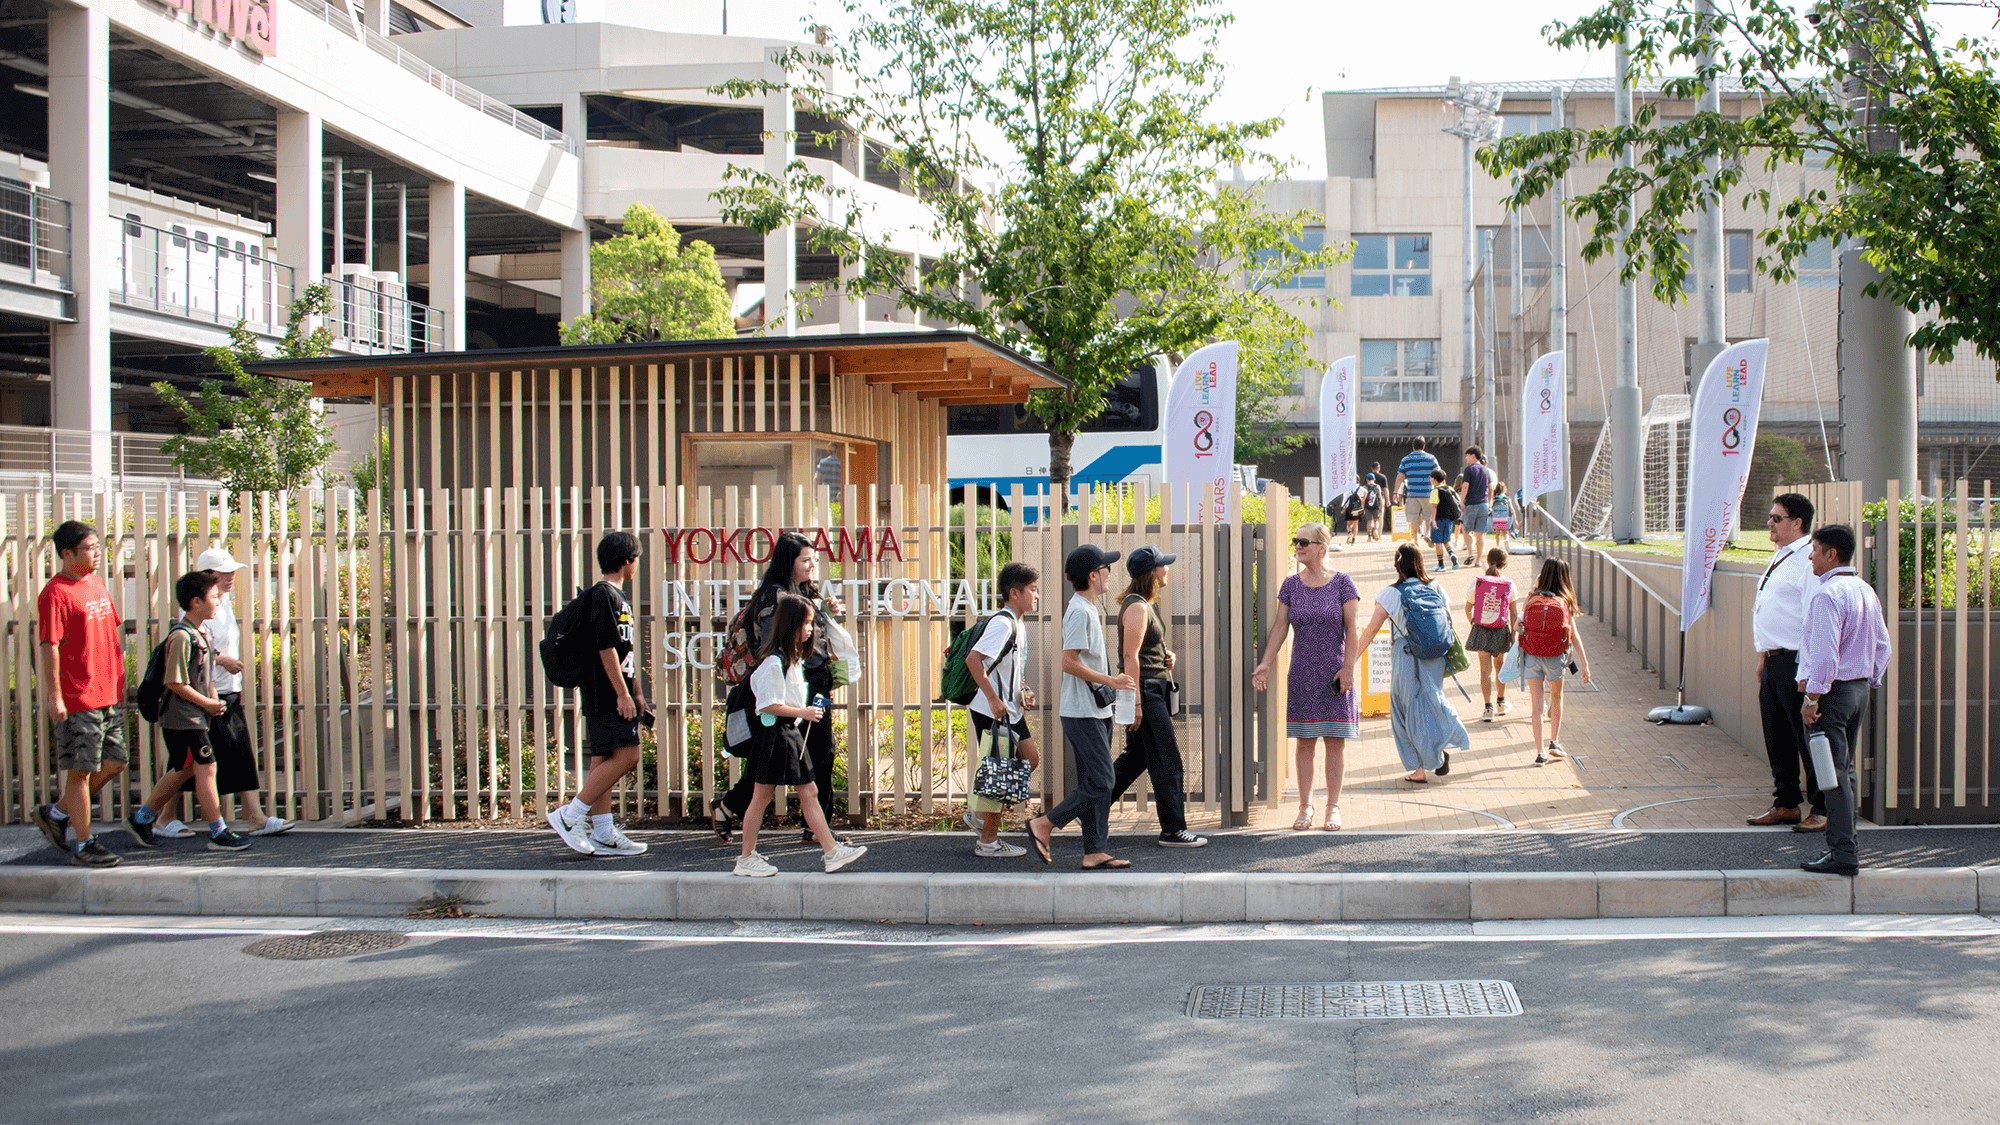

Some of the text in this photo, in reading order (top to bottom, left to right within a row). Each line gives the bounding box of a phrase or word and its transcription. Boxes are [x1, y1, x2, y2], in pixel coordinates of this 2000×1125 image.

[1195, 369, 1203, 391] LIVE
[1202, 372, 1210, 405] LEARN
[1209, 361, 1217, 388] LEAD
[1726, 366, 1734, 388] LIVE
[1732, 369, 1740, 402] LEARN
[1339, 439, 1347, 486] COMMUNITY
[1214, 477, 1225, 524] YEARS
[661, 526, 904, 564] YOKOAMA
[662, 578, 1001, 618] INTEATIONAL
